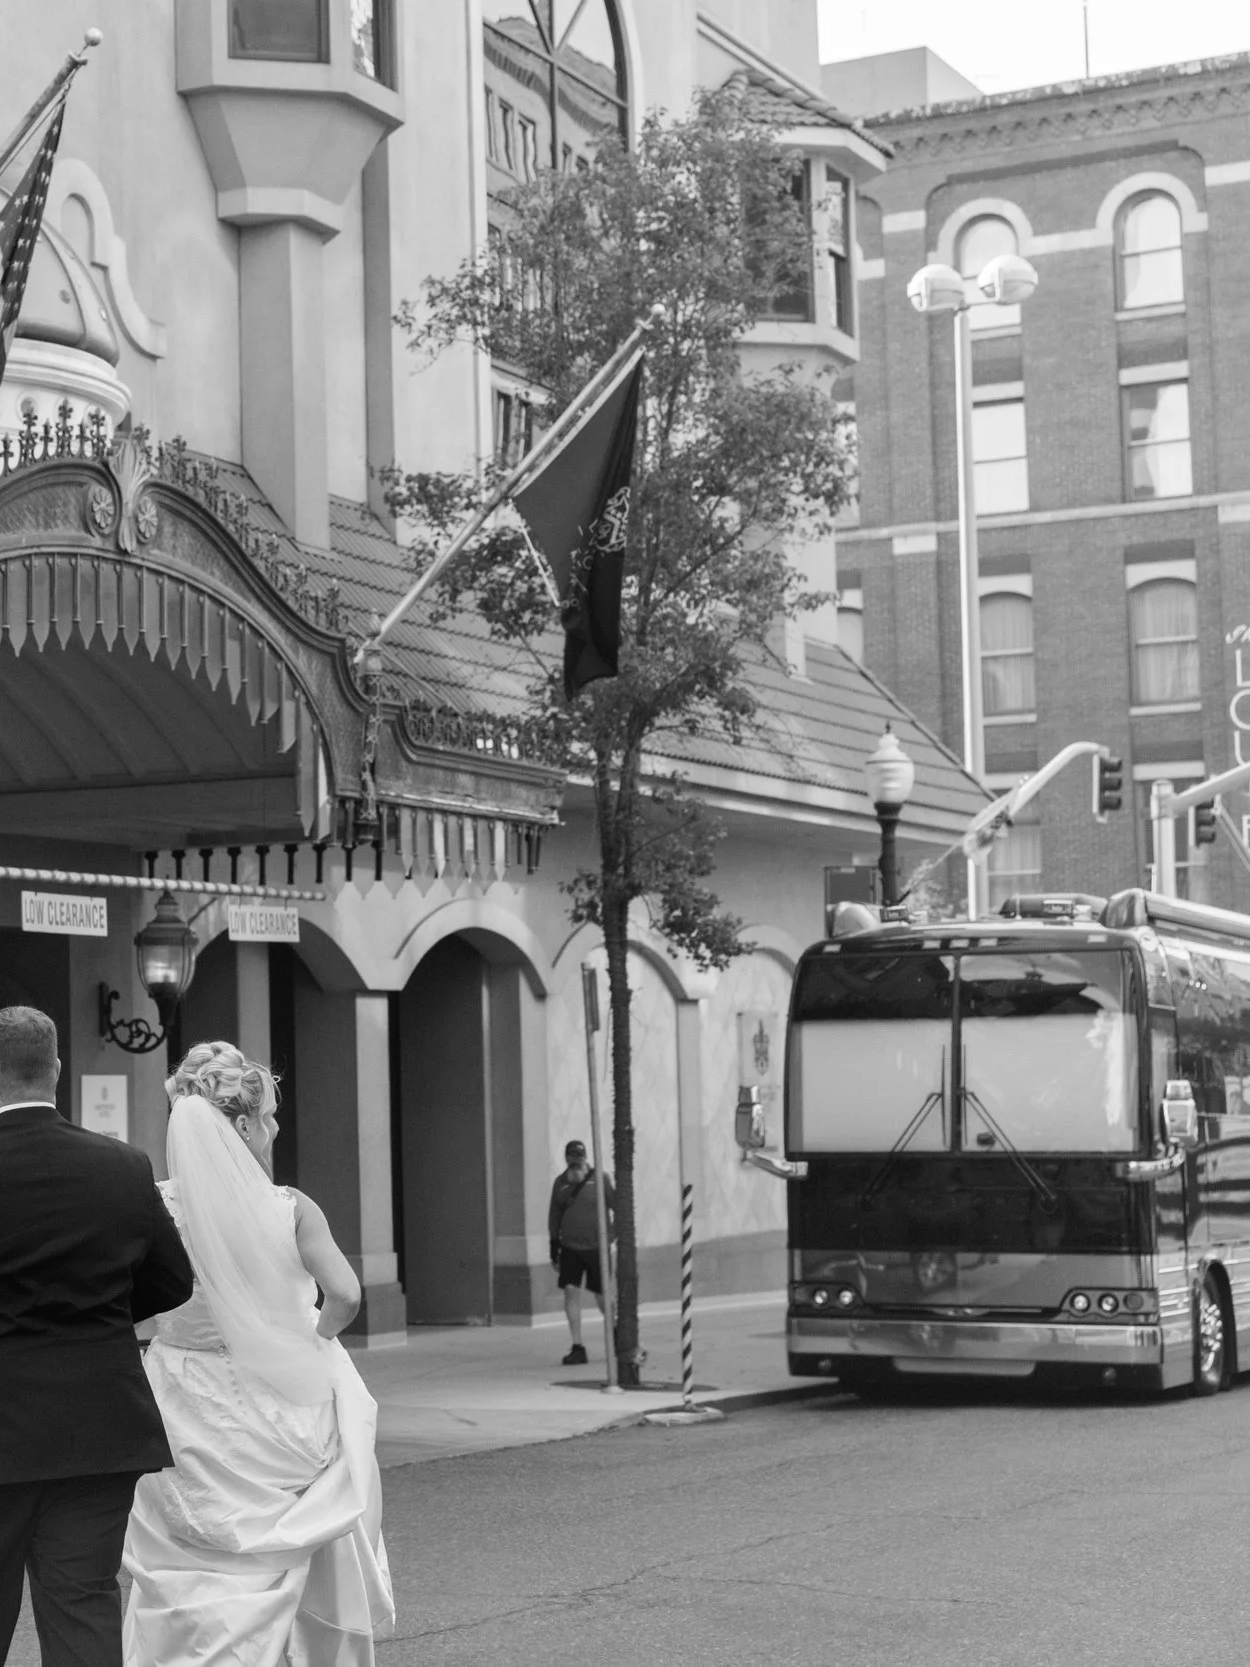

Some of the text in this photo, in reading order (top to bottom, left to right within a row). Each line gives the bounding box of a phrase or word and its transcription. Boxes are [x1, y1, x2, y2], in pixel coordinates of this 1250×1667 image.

[25, 898, 105, 929] LOW CLEARANCE
[230, 911, 297, 935] LOW CLEARANCE
